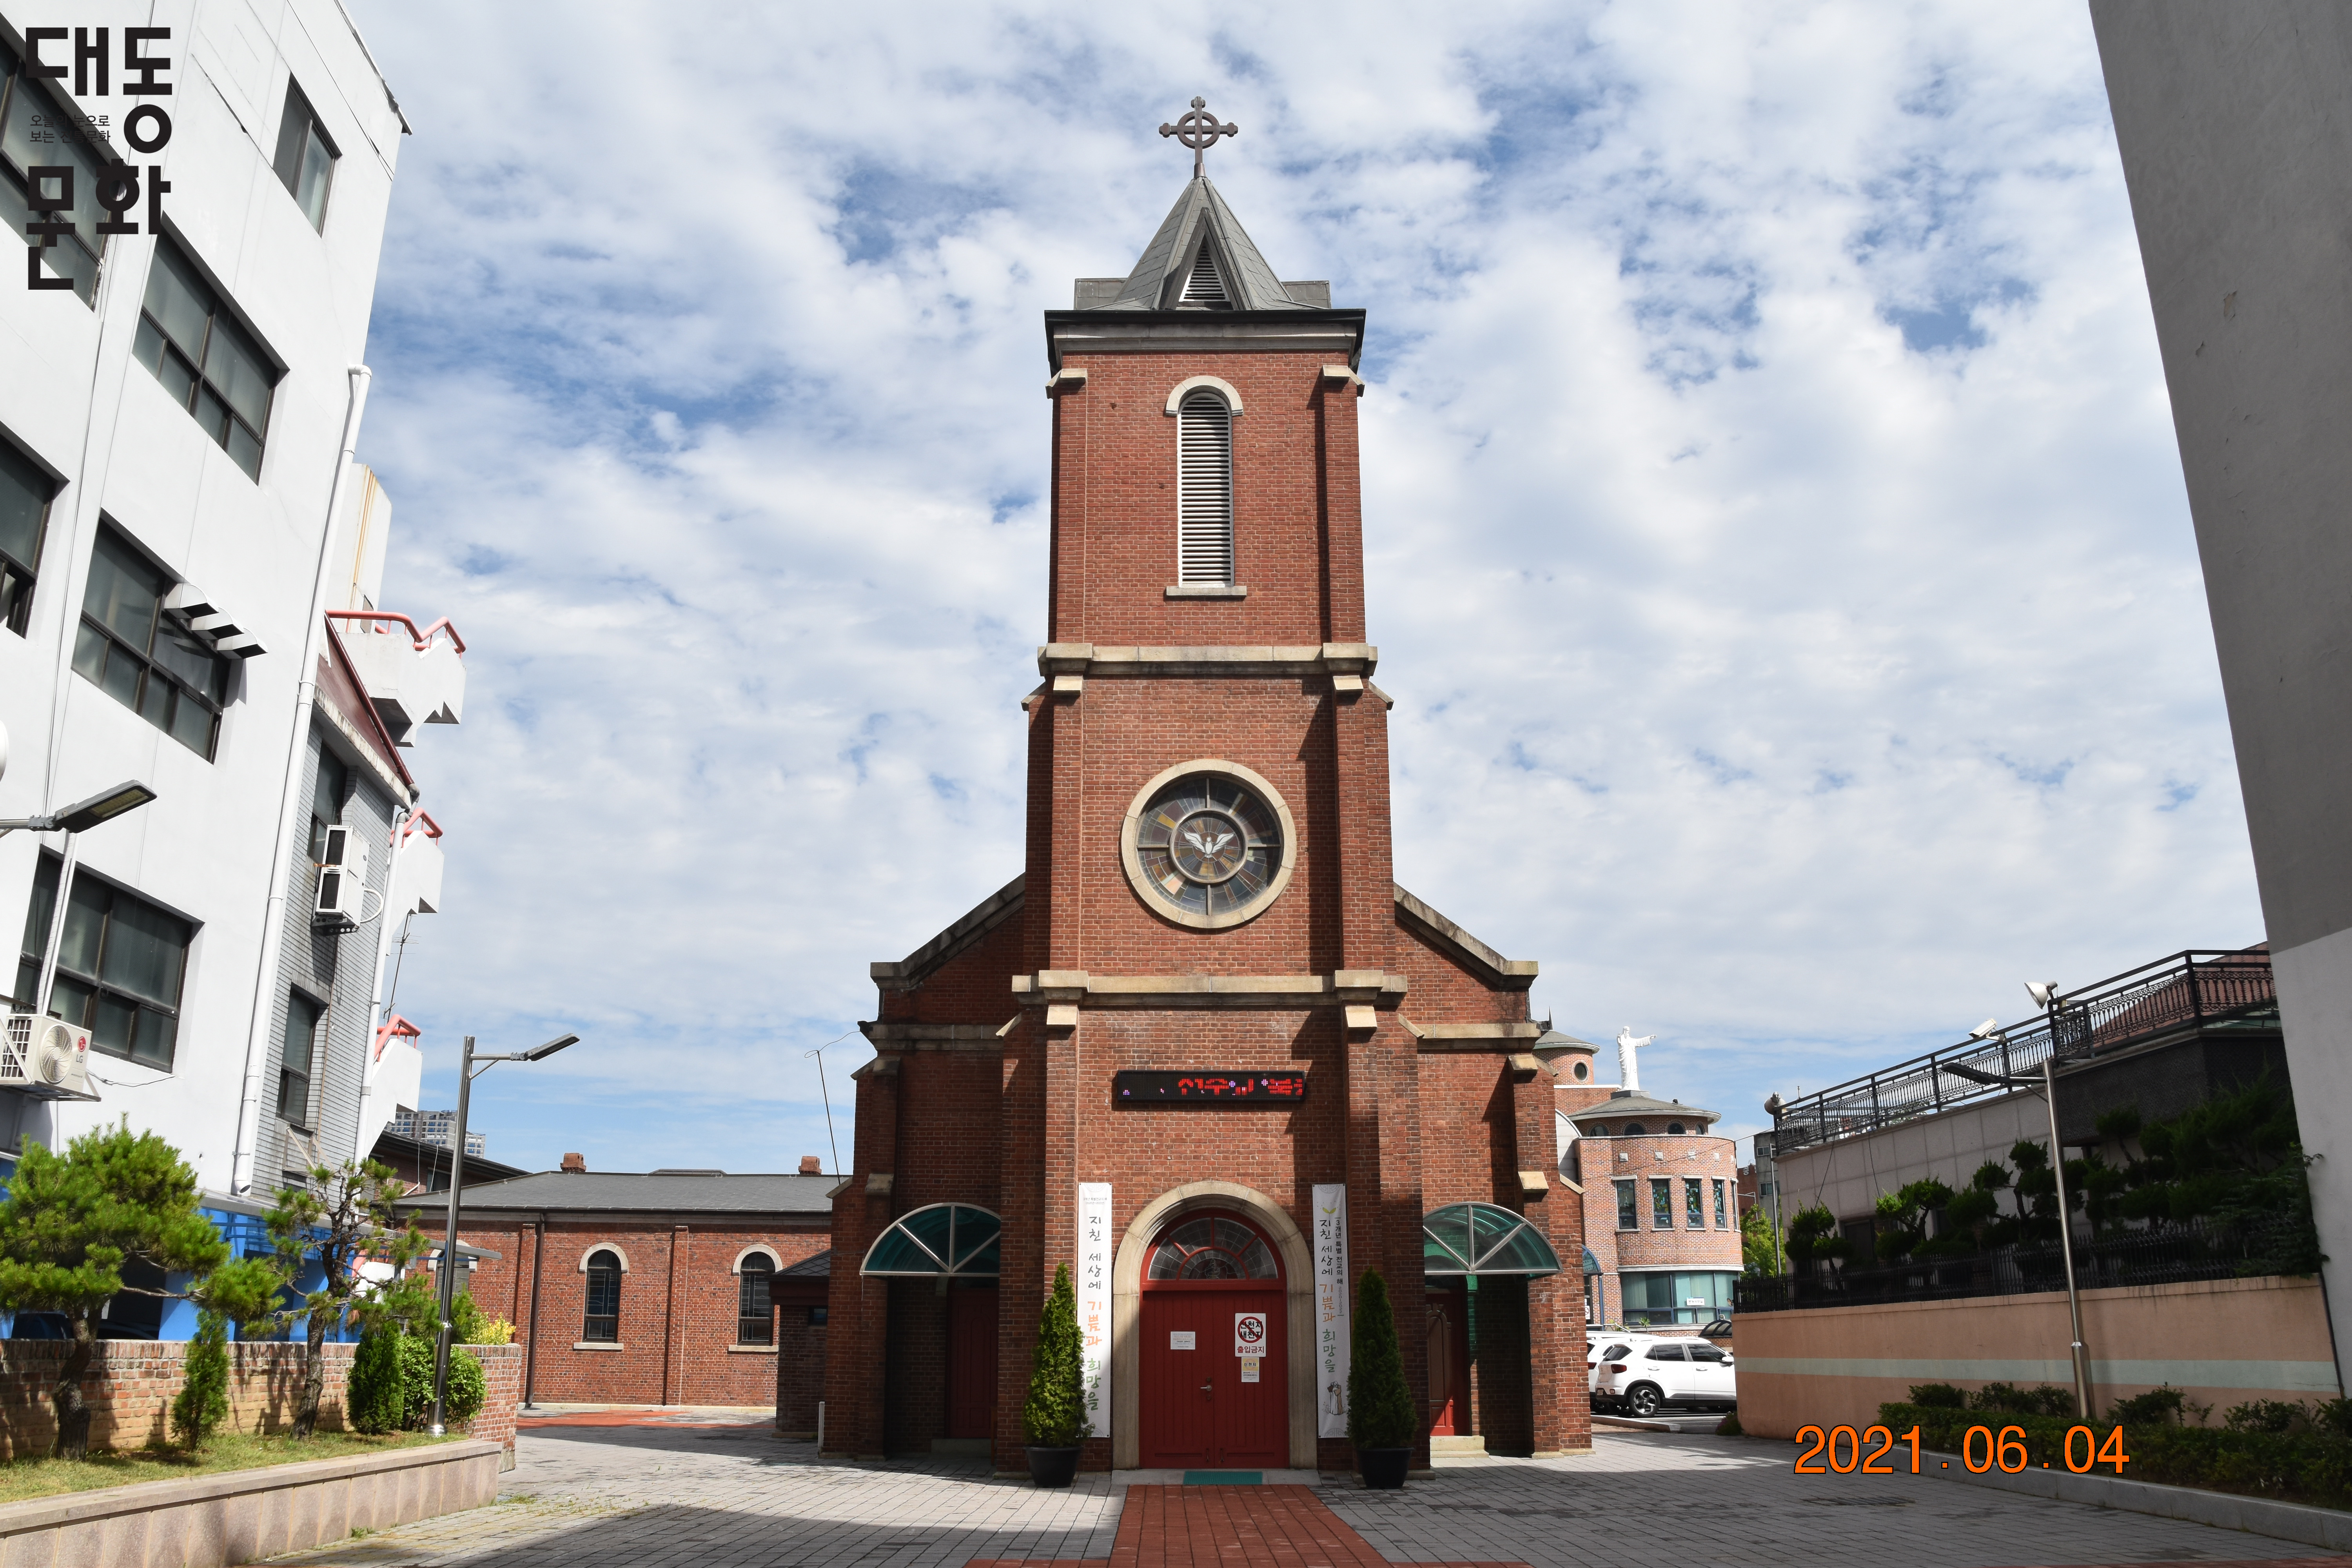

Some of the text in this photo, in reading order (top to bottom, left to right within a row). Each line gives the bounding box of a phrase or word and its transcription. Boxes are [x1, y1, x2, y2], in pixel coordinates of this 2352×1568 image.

[76, 1054, 83, 1063] LG
[1335, 1241, 1342, 1254] 특별
[1086, 1216, 1102, 1411] 지친 세상에 기쁨과 희망을
[1319, 1220, 1336, 1373] 지친 세상에 기쁨과 희망을
